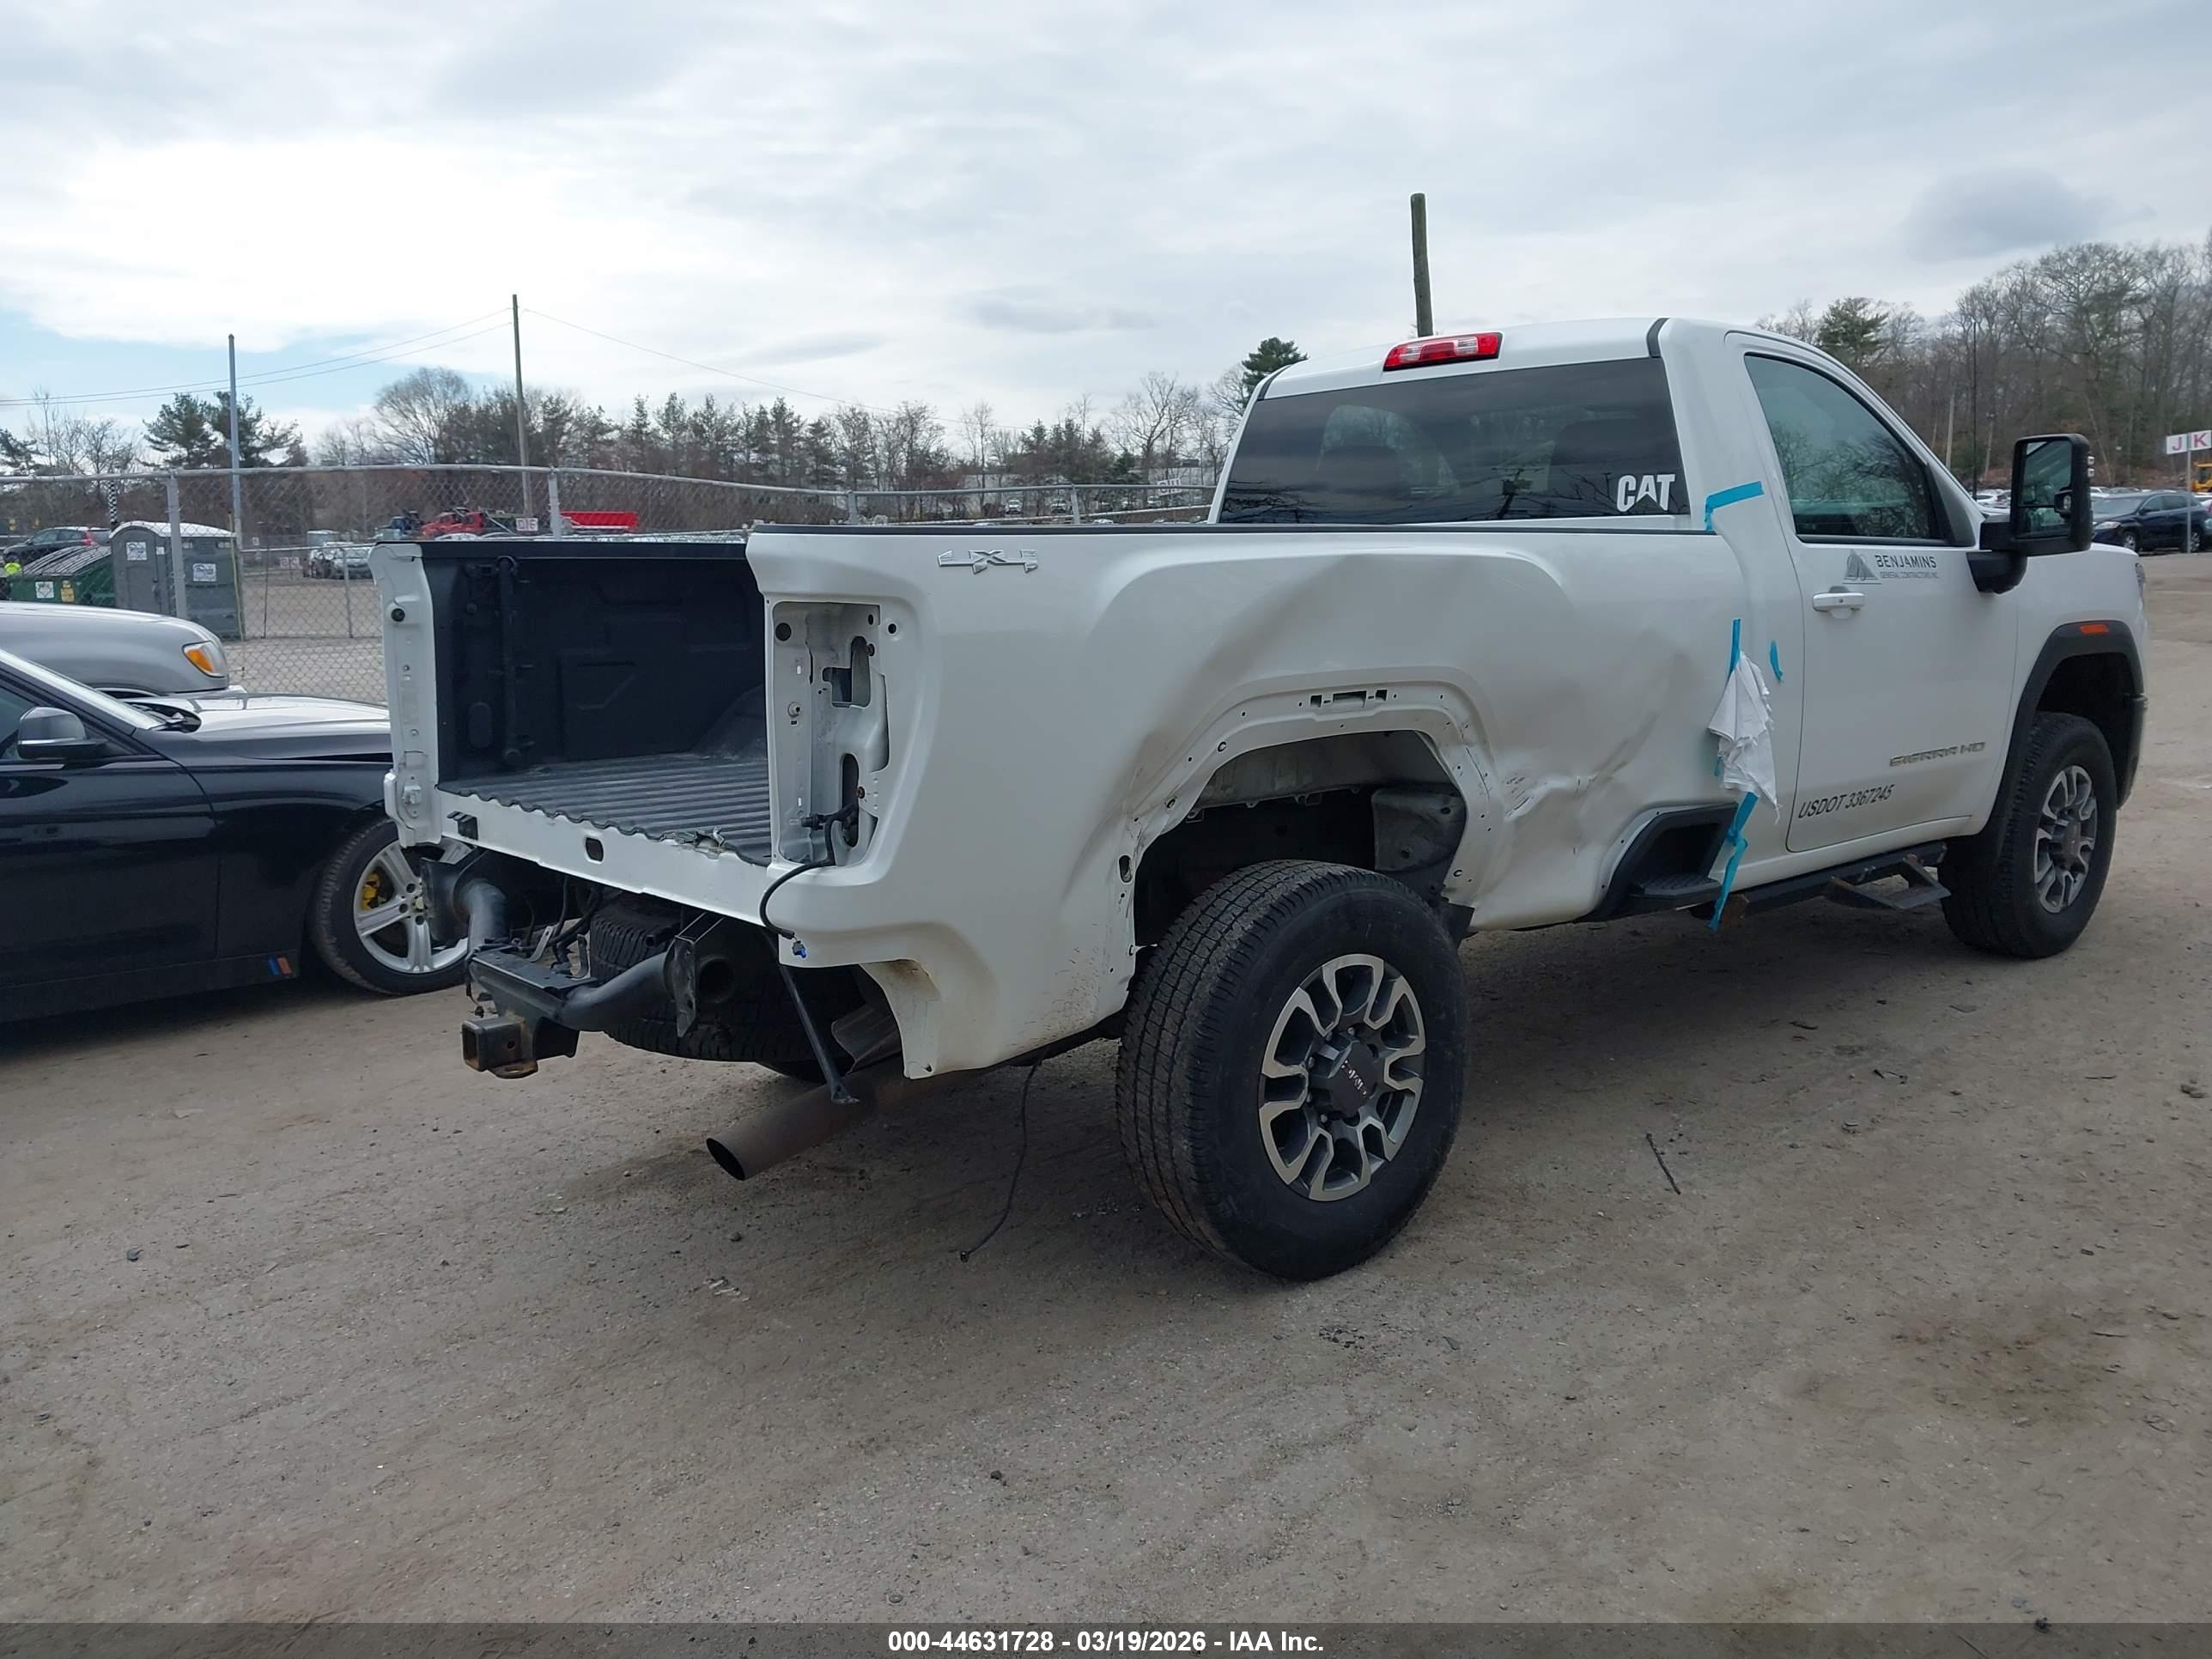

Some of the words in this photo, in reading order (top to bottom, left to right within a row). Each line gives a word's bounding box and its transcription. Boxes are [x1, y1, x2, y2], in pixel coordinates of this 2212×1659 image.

[2172, 436, 2182, 451] J
[2194, 432, 2209, 448] K
[1616, 473, 1676, 513] CAT
[1875, 555, 1936, 568] BENJAMINS
[1889, 745, 1959, 767] SIERRA
[1960, 741, 1986, 755] HD
[1798, 793, 1848, 819] USDOT
[1845, 783, 1895, 809] 3367245
